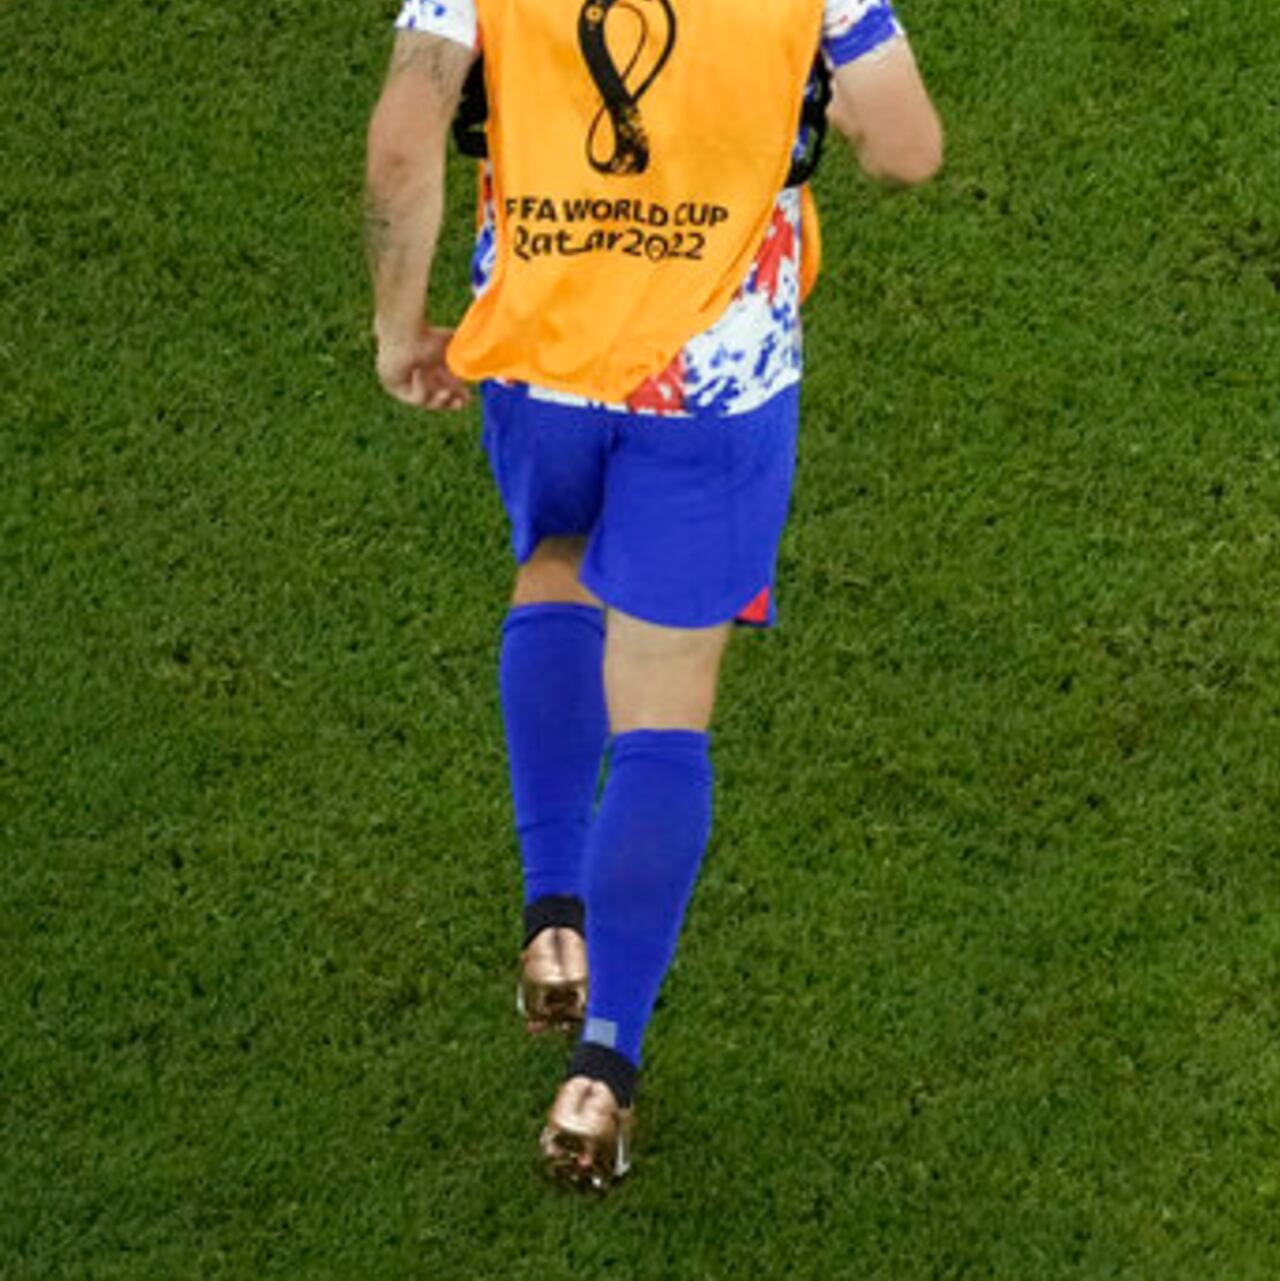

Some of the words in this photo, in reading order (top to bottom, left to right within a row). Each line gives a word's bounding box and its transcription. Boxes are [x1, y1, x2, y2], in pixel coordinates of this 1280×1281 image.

[505, 195, 557, 221] FFA
[562, 198, 668, 227] WORLD
[674, 202, 728, 227] CUP
